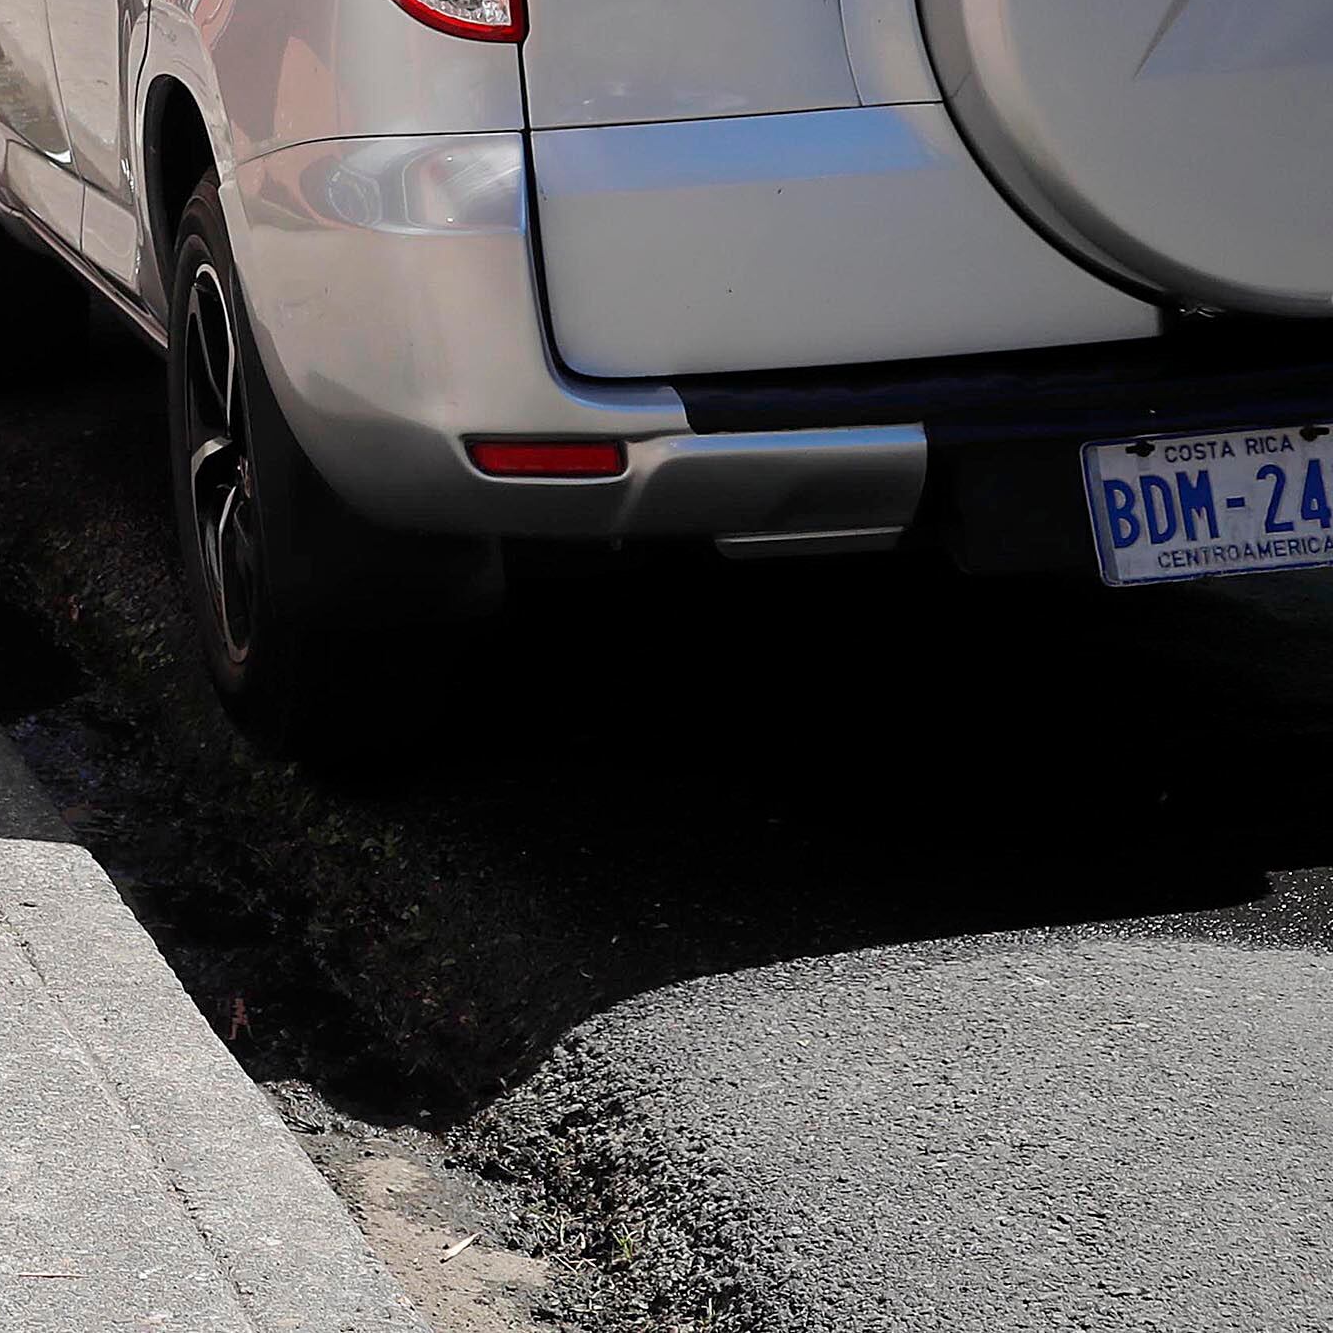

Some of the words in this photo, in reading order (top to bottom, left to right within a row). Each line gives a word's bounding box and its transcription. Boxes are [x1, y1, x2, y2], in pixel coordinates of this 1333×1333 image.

[1164, 440, 1235, 464] COSTA
[1245, 433, 1294, 456] RICA
[1157, 537, 1333, 569] CENTROAMERICA
